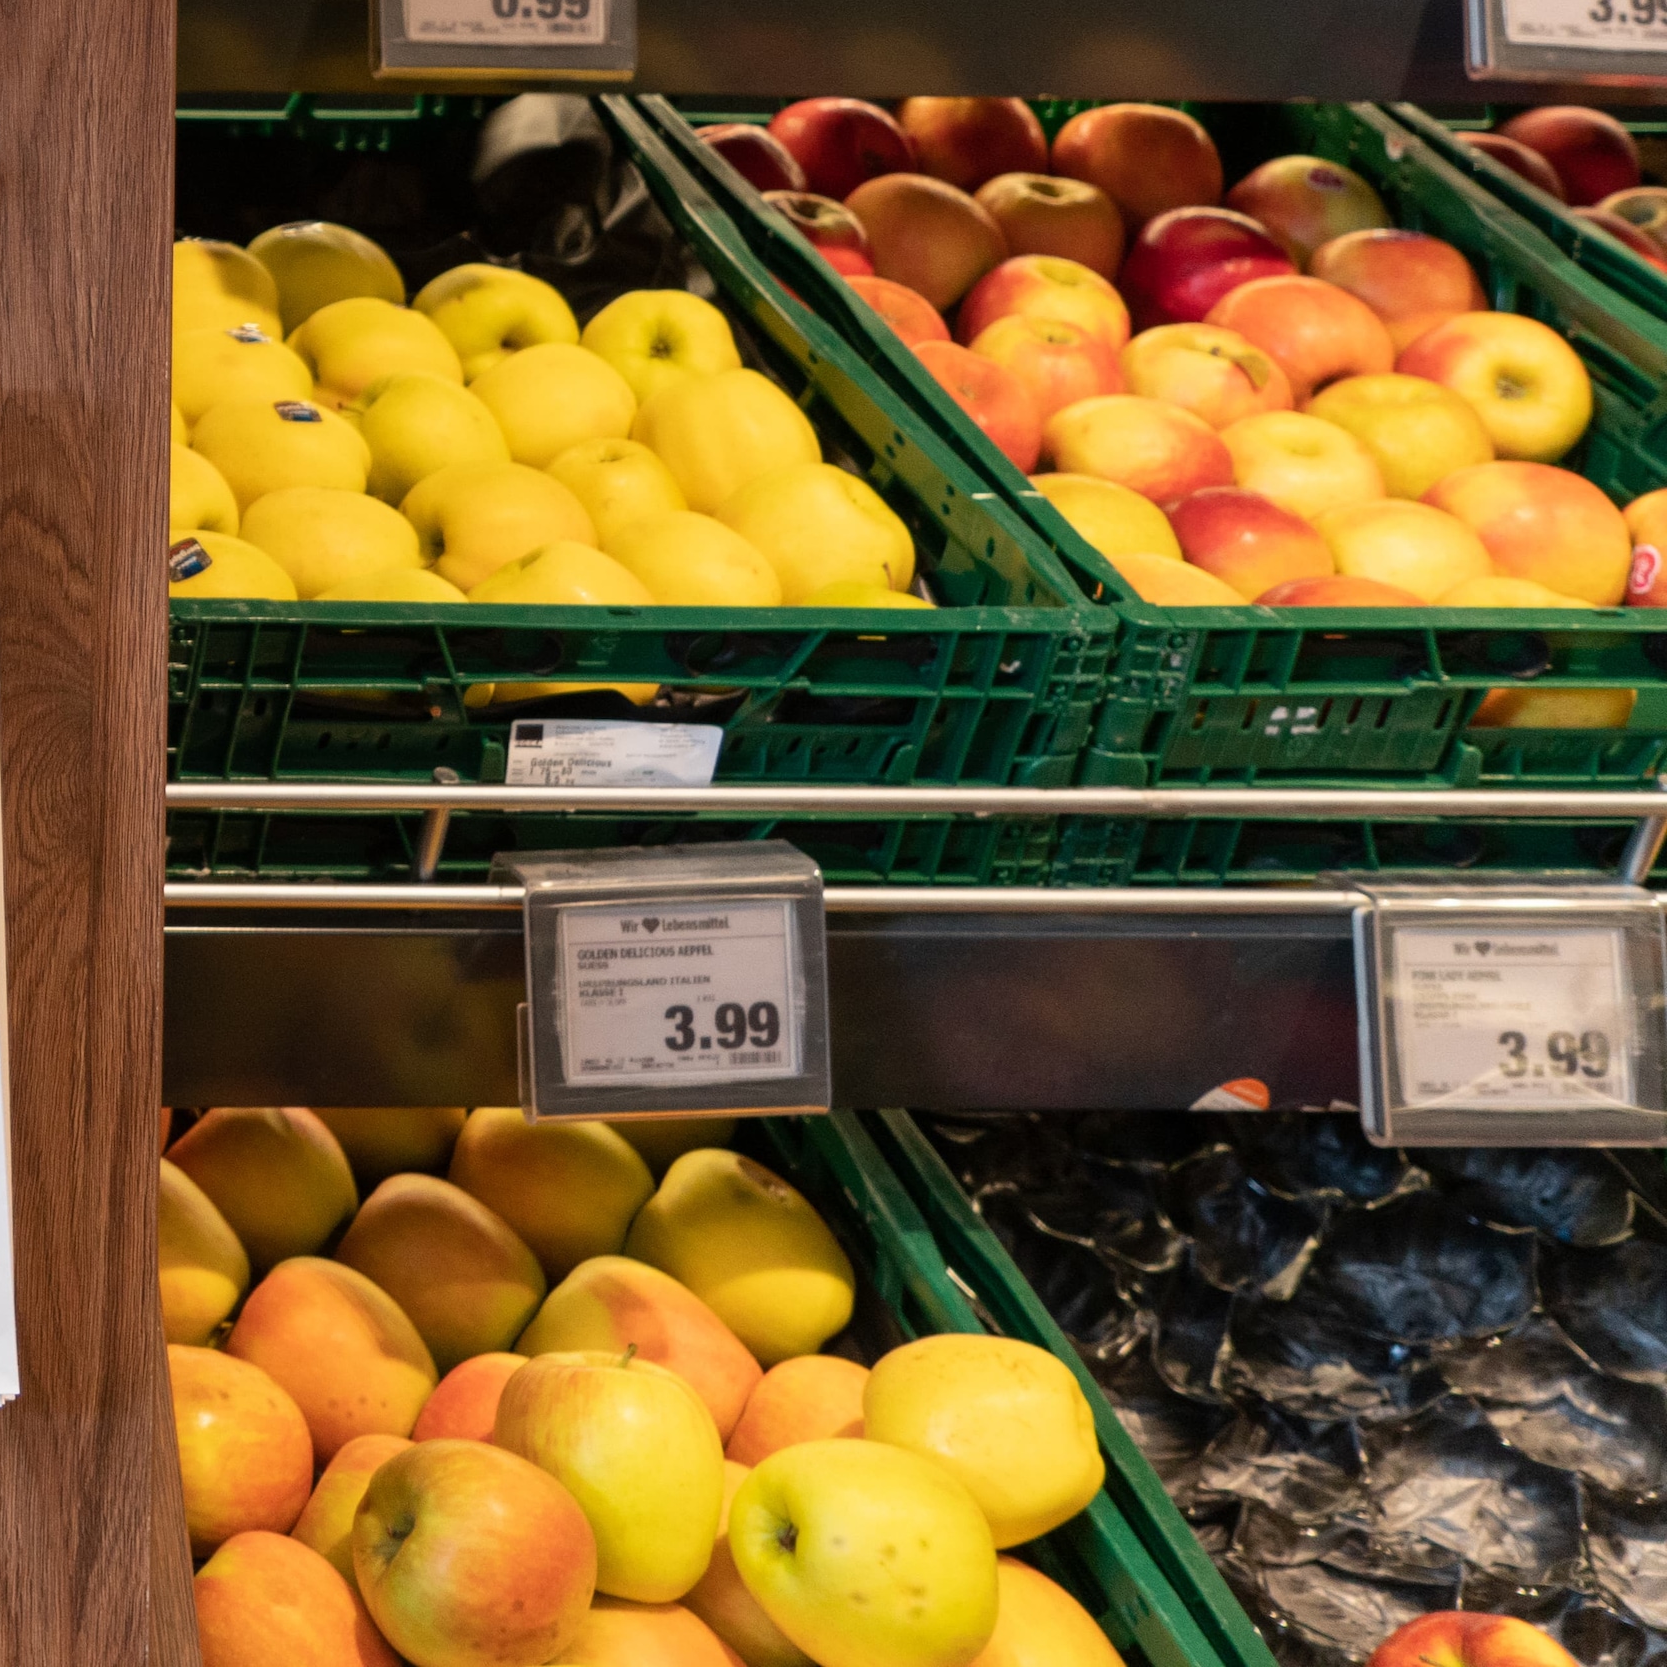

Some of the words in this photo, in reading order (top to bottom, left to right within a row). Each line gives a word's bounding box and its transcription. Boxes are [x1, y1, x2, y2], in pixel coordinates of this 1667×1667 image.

[620, 918, 639, 933] Wir
[577, 948, 618, 961] GOLDEN
[620, 946, 675, 959] DELICIOUS
[678, 943, 714, 957] AEPFEL
[663, 1001, 781, 1052] 3.99
[1498, 1030, 1610, 1079] 3.99
